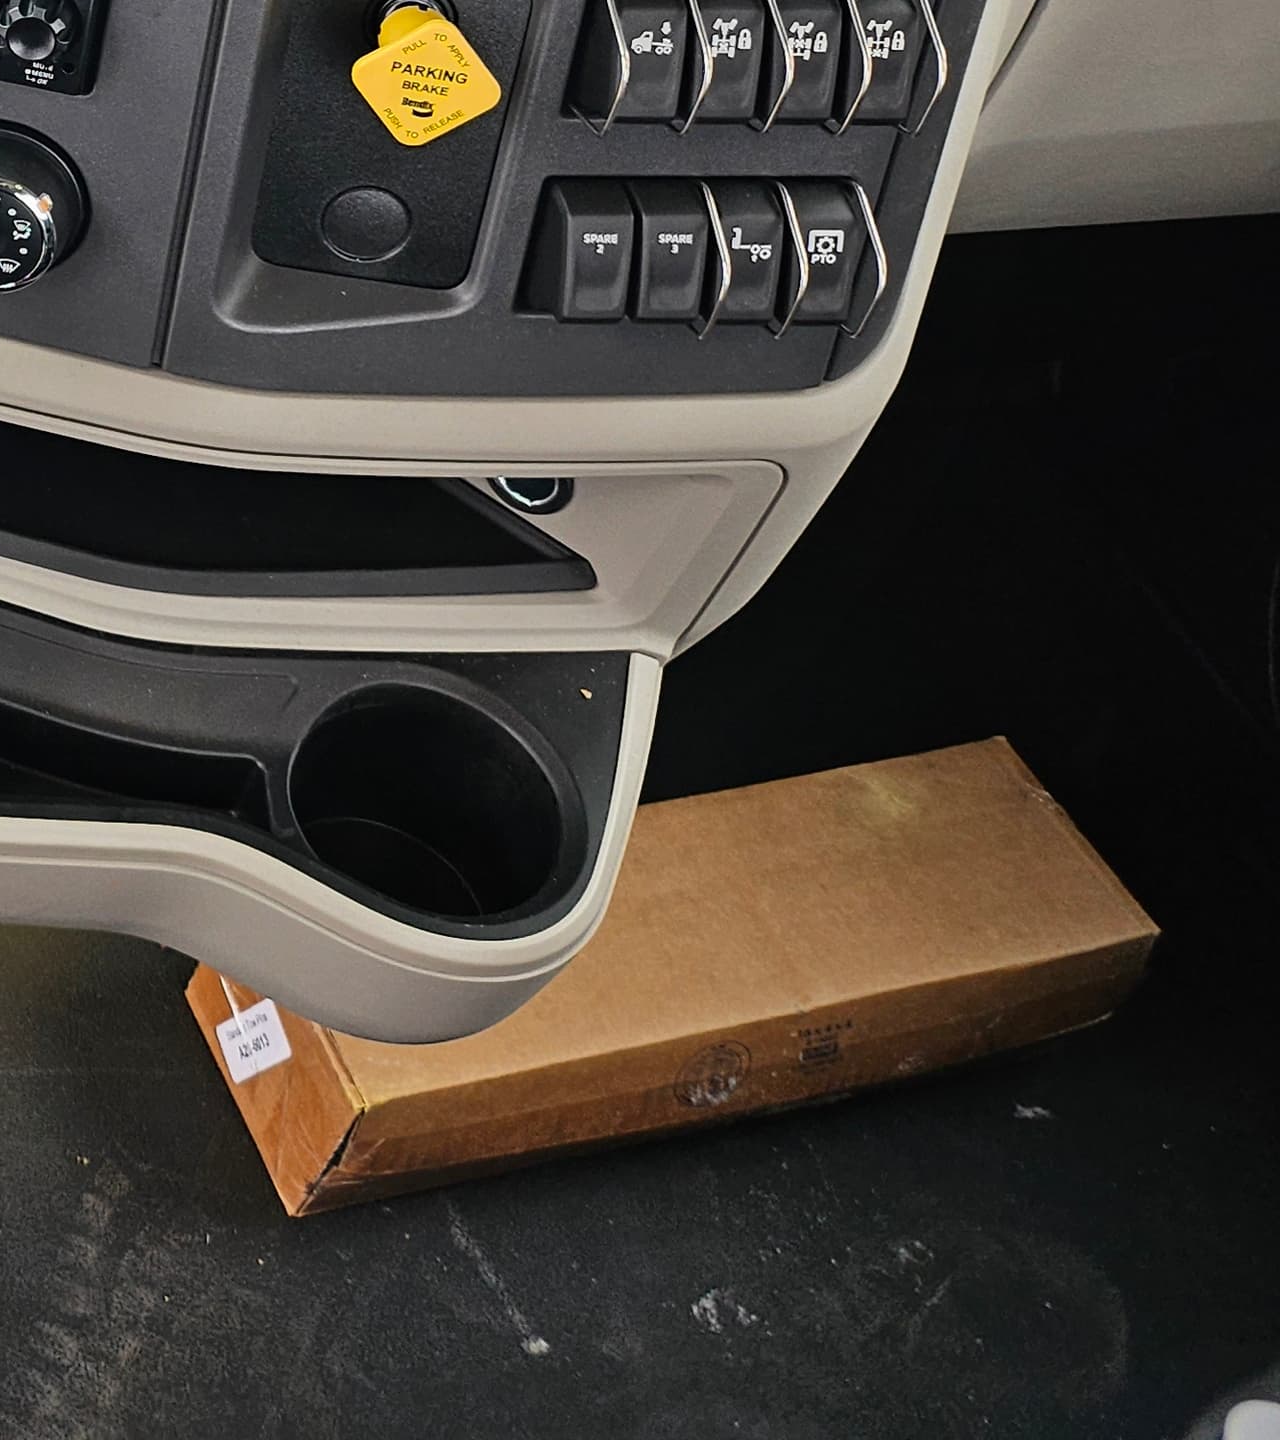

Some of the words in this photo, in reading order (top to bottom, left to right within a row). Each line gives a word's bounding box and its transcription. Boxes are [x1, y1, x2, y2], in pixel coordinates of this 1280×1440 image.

[401, 39, 427, 55] PULL
[433, 33, 448, 42] TO
[447, 43, 471, 68] APPLY
[390, 61, 468, 85] PARKING
[401, 80, 449, 97] BRAKE
[383, 107, 403, 130] PUSH
[405, 130, 419, 139] TO
[423, 110, 465, 135] RELEASE
[583, 233, 618, 246] SPARE
[658, 233, 693, 246] SPARE
[810, 253, 836, 264] PTO
